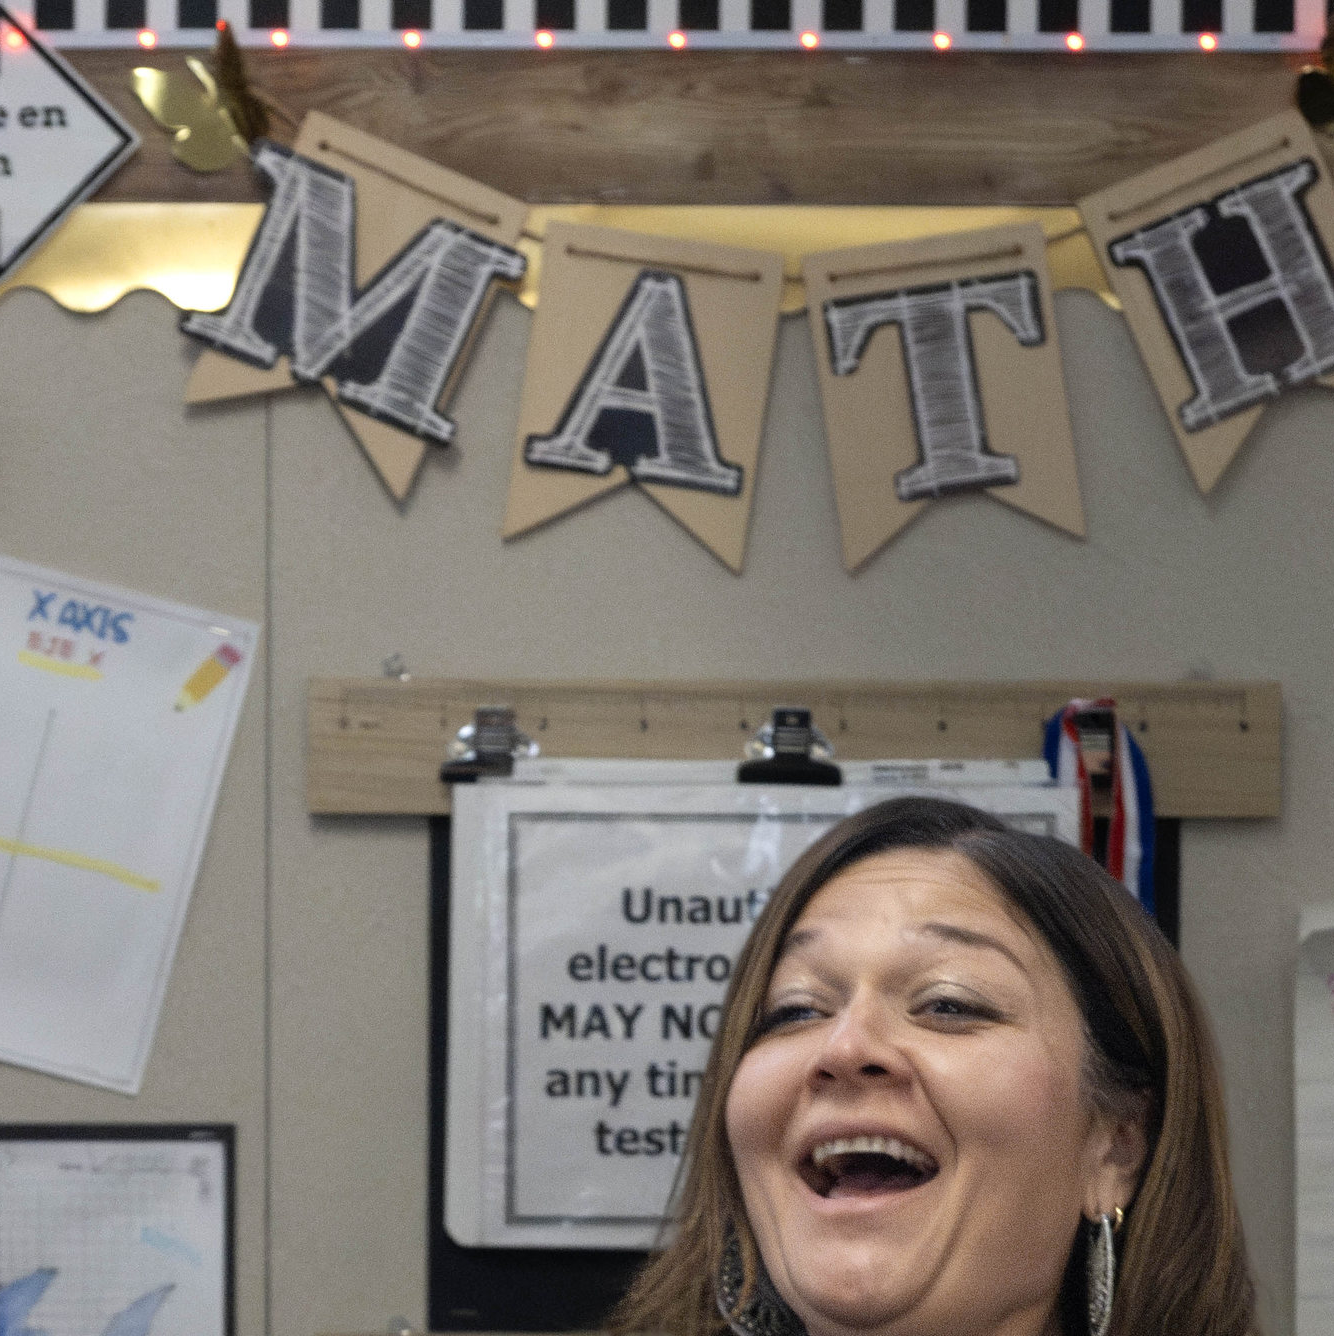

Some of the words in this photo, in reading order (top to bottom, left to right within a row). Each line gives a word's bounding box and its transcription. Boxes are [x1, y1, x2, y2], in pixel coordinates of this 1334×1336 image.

[19, 105, 68, 129] en
[539, 1003, 645, 1041] MAY
[544, 1069, 630, 1106] any
